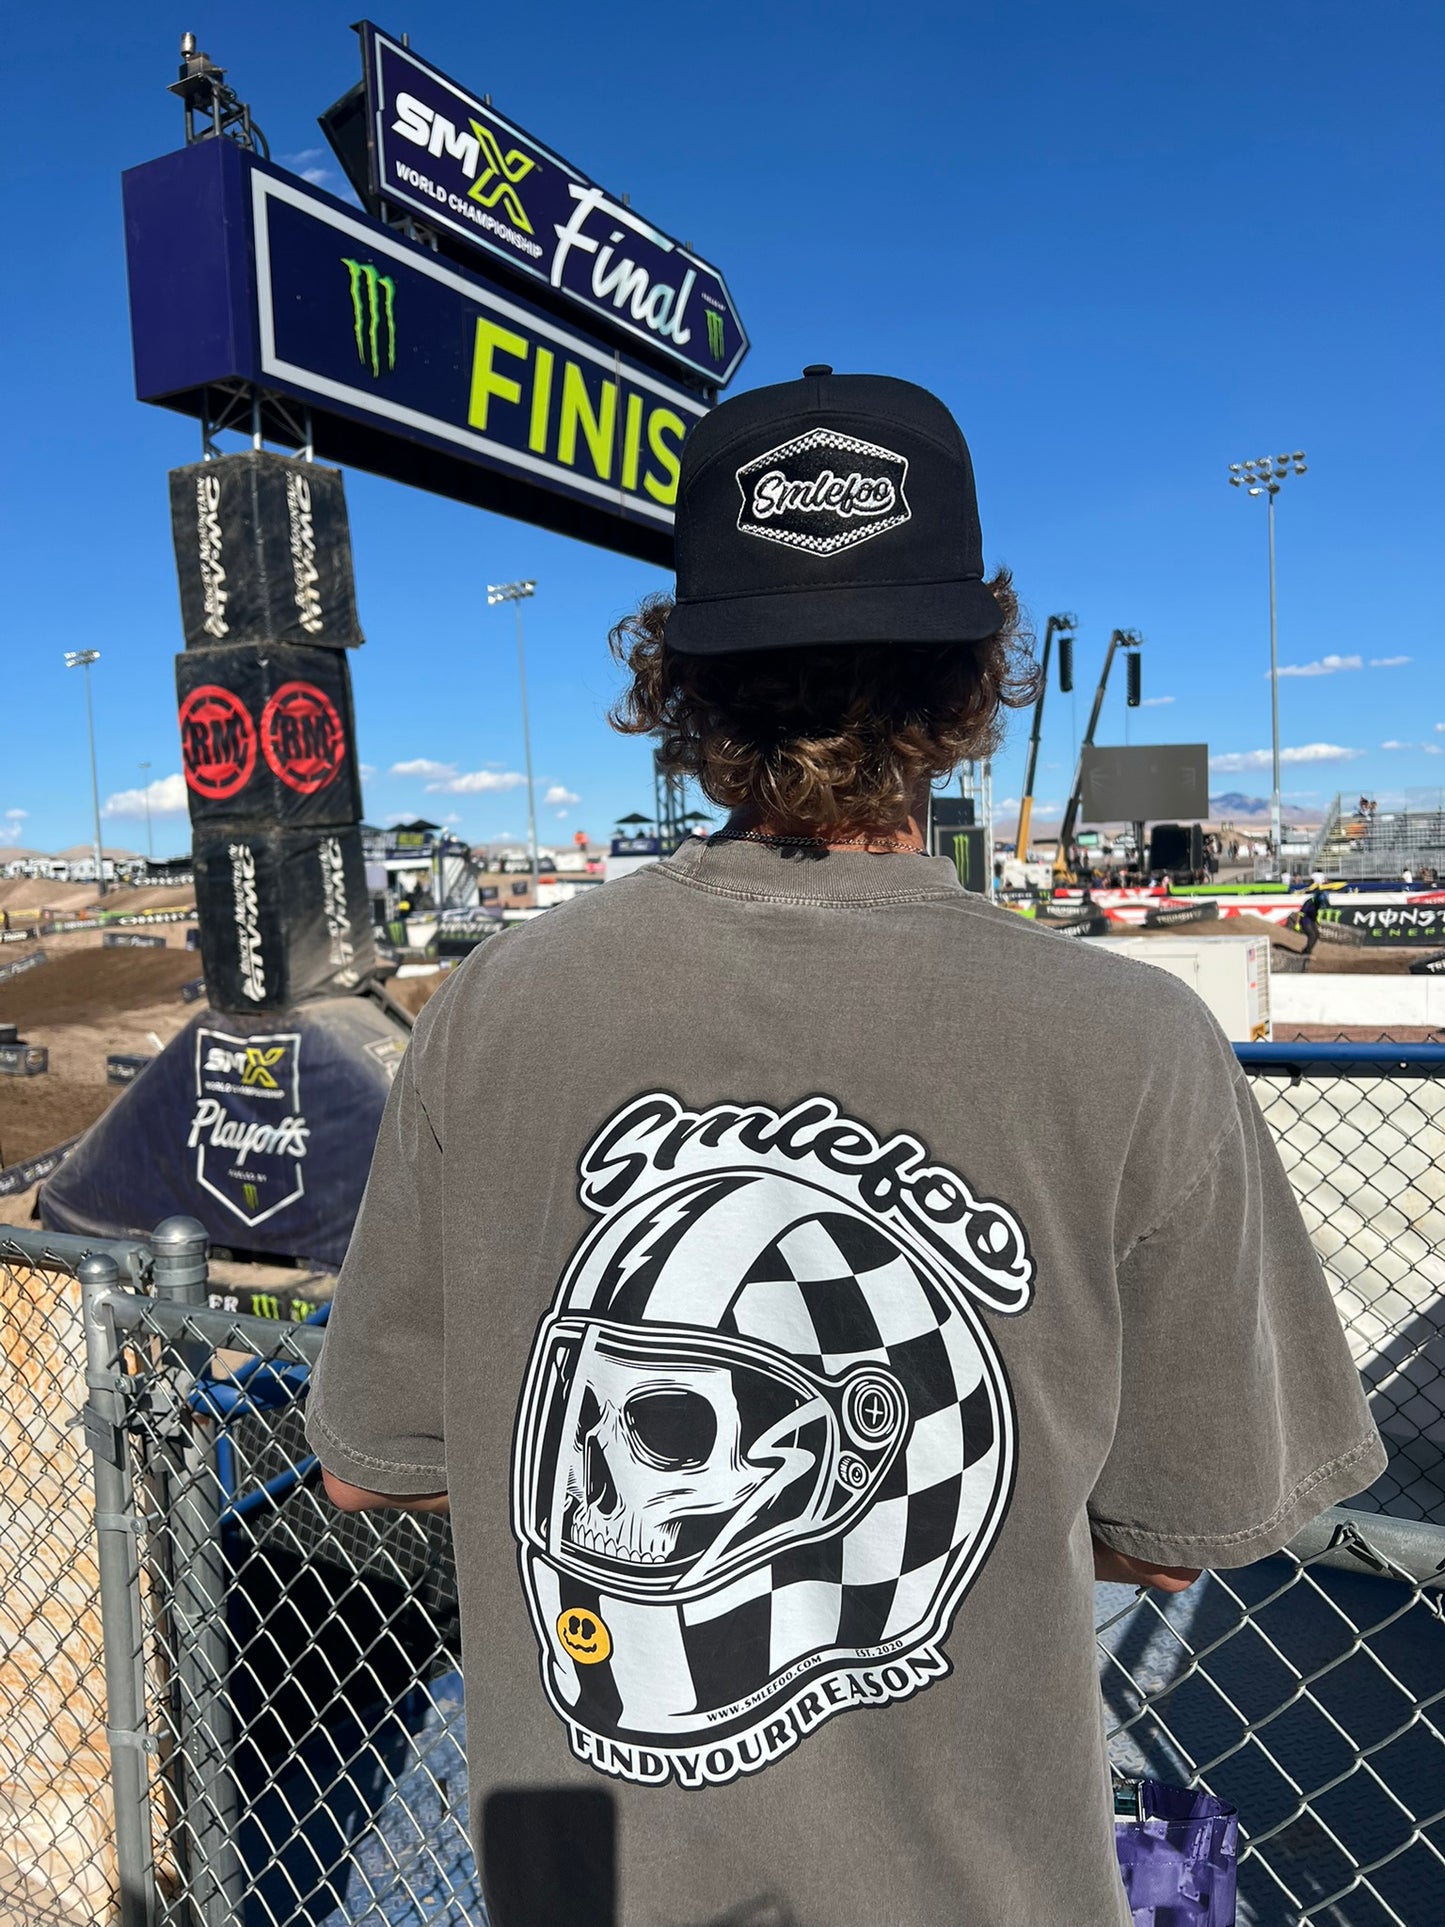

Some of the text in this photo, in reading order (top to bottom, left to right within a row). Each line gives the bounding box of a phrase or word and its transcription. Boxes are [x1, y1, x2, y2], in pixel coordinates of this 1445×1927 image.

[391, 92, 536, 235] SMX
[395, 160, 543, 259] WORLD CHAMPIONSHIP
[551, 183, 697, 345] Final
[468, 316, 686, 505] FINIS
[752, 470, 895, 519] Smlefoo
[203, 1047, 286, 1088] SMX
[187, 1098, 310, 1166] Playoffs
[580, 1094, 1033, 1313] Smlefoo
[575, 1646, 943, 1780] FIND YOUR REASON
[707, 1640, 904, 1722] WWW.SMLEFOO.COM EST. 2020
